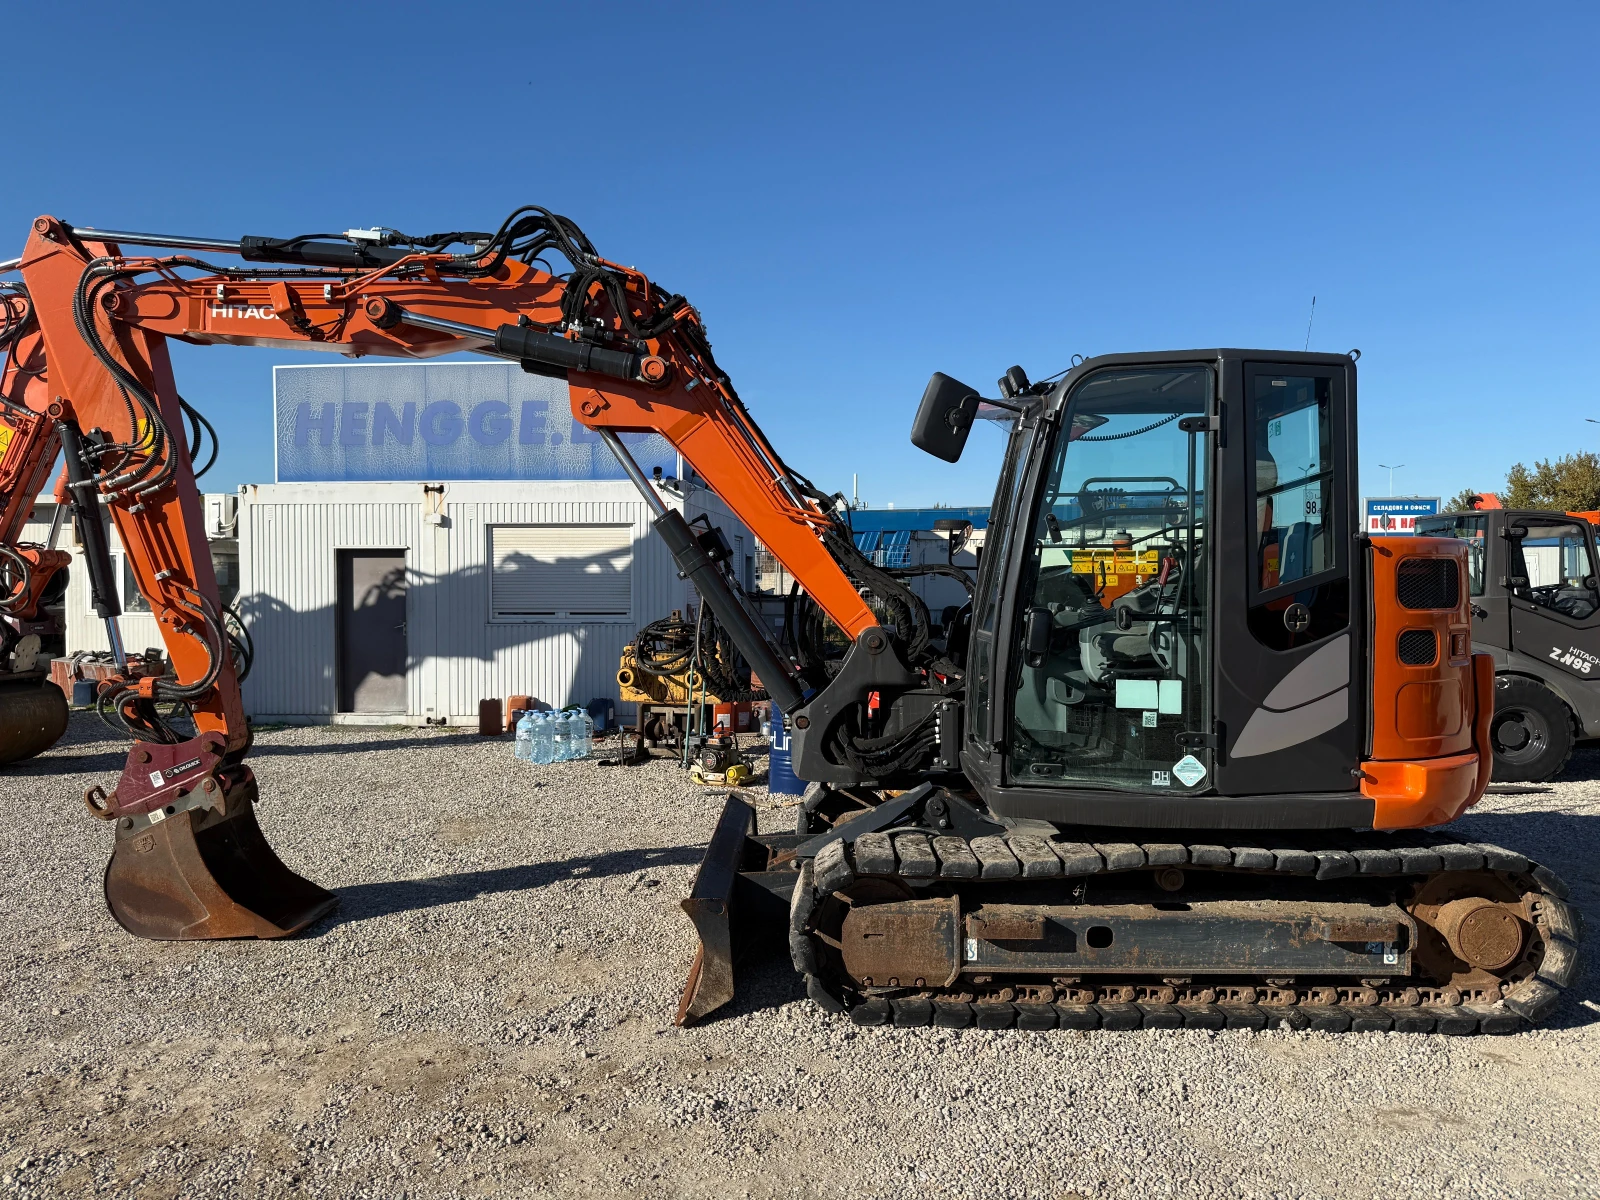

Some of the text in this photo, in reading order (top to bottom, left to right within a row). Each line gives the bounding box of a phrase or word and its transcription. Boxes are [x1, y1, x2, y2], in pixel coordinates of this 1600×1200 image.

[211, 303, 281, 320] HITAC
[1305, 501, 1317, 514] 98
[1371, 517, 1397, 530] ПД
